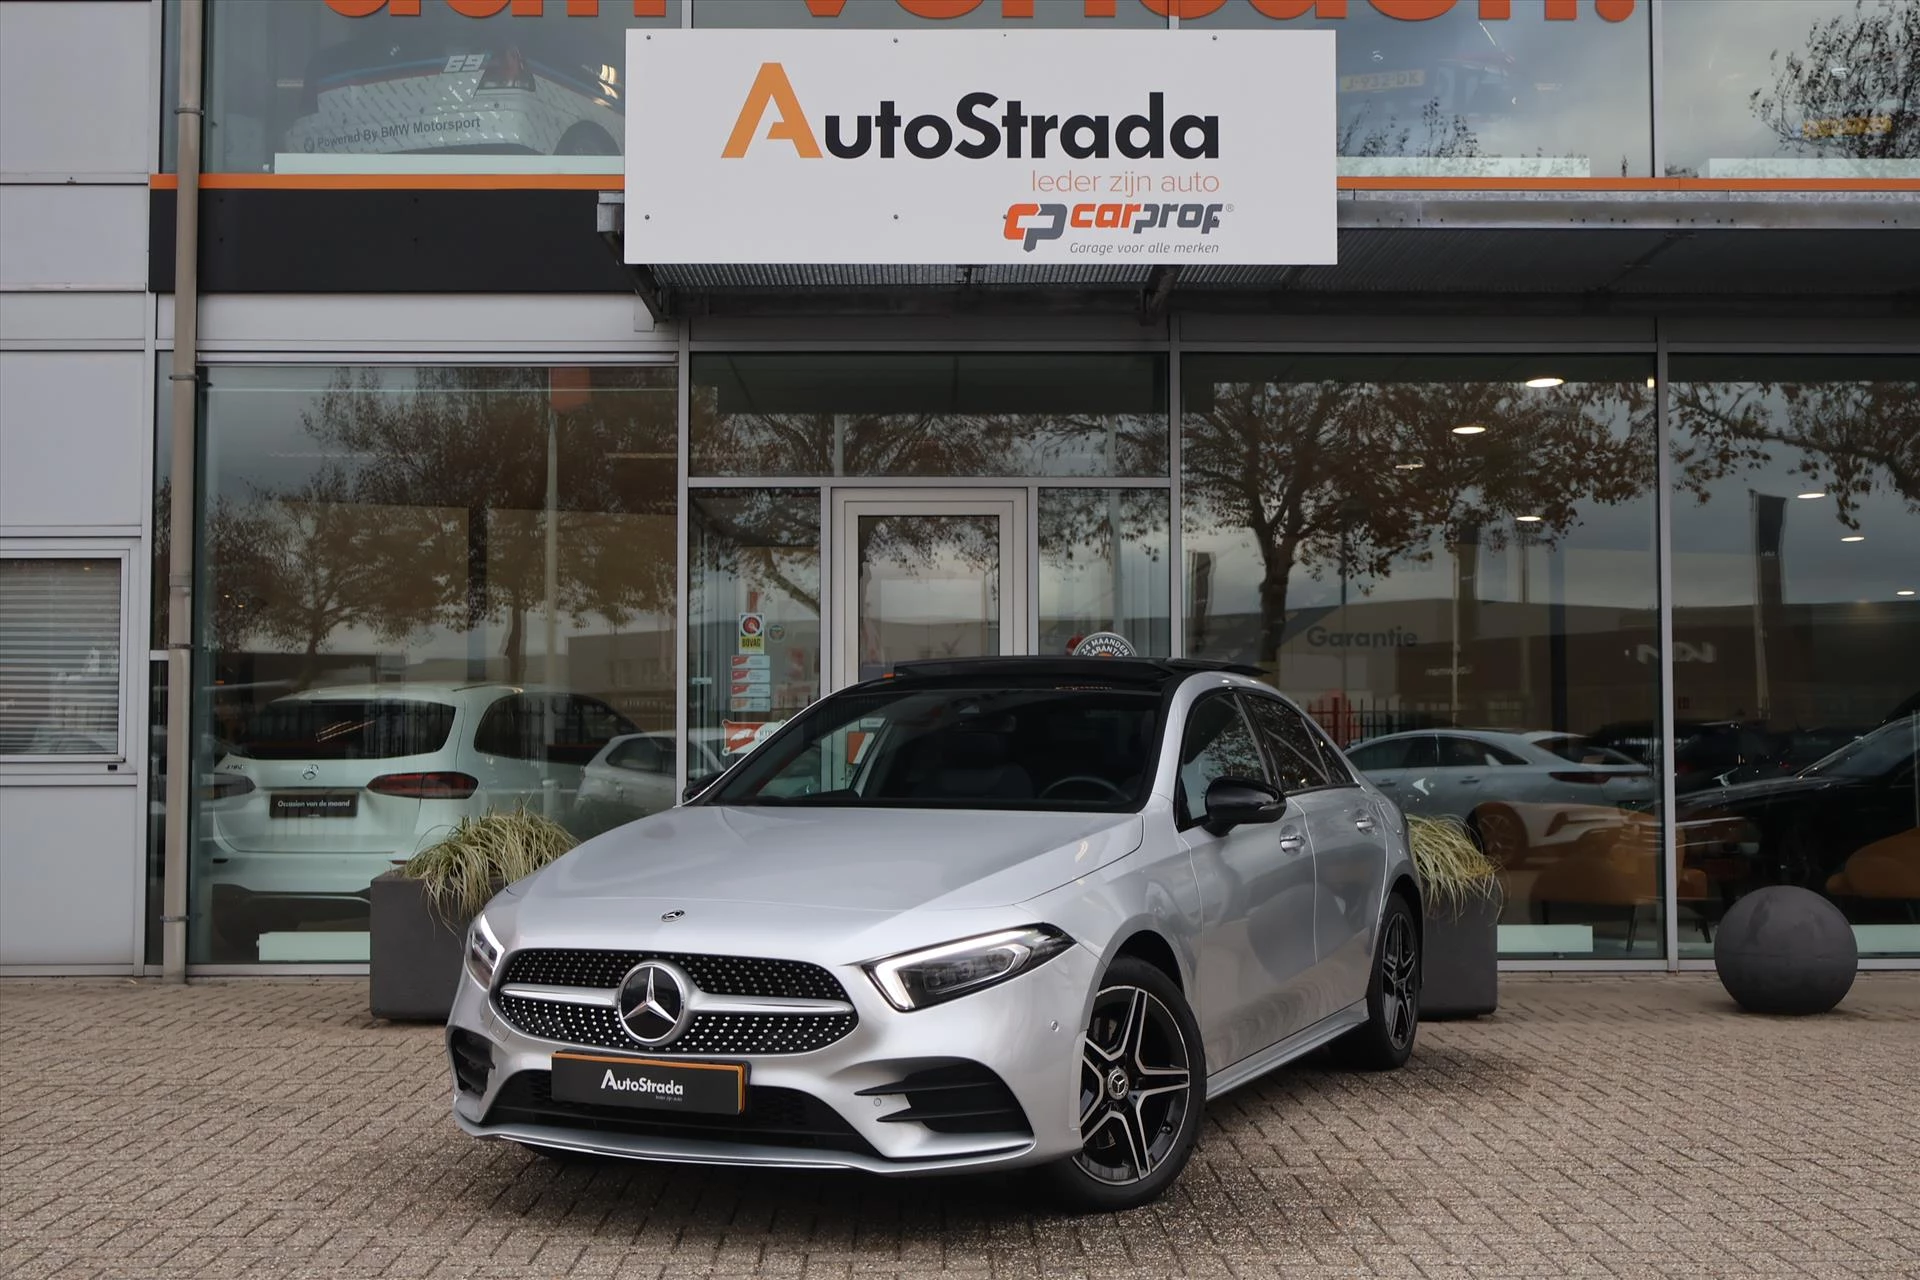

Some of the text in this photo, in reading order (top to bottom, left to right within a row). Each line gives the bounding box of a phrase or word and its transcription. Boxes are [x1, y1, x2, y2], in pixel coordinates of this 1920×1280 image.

[443, 54, 486, 73] 69
[720, 62, 1219, 159] AutoStrada
[317, 117, 481, 148] Powered By BMW Motorsport
[1032, 170, 1220, 198] Ieder zijn auto
[1070, 241, 1219, 255] Garage voor alle merken
[741, 637, 761, 648] BOVAG
[1307, 625, 1418, 647] Garantie
[1081, 637, 1130, 656] 24 MAANDEN
[319, 800, 327, 808] de
[601, 1069, 683, 1095] AutoStrada
